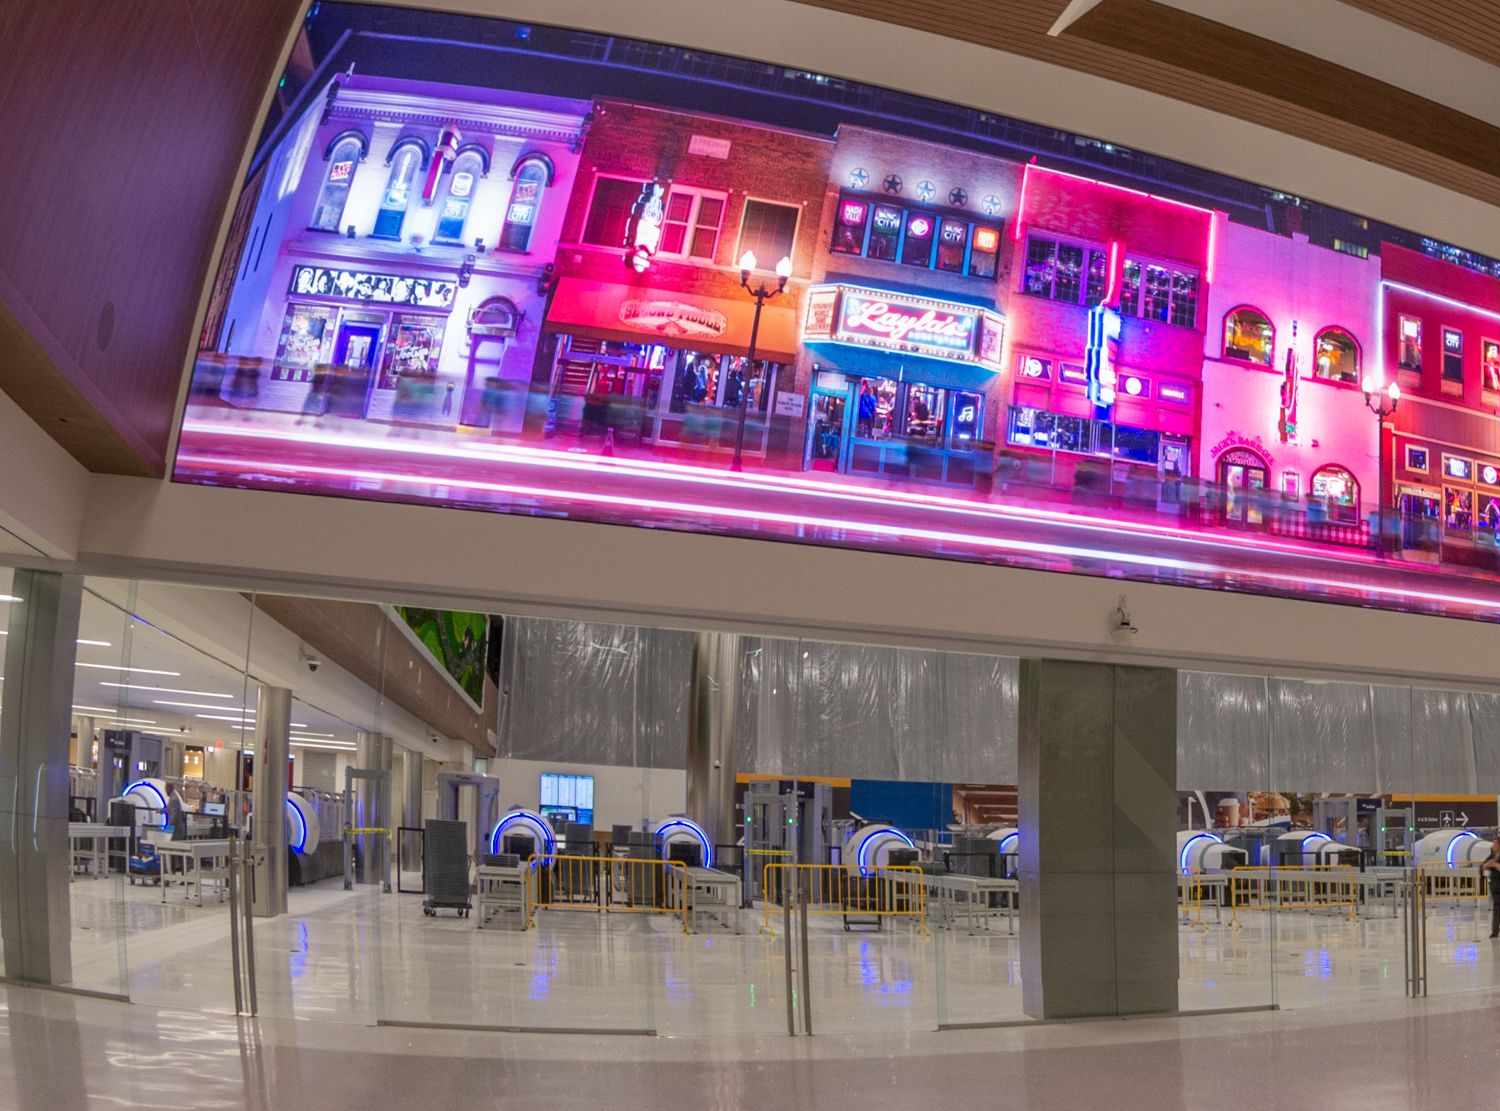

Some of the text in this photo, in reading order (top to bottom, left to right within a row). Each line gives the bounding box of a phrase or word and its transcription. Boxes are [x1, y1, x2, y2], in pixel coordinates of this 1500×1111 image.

[877, 219, 897, 228] CITY
[944, 231, 961, 241] CITY
[847, 302, 968, 339] Layla's
[1446, 338, 1460, 348] CITY
